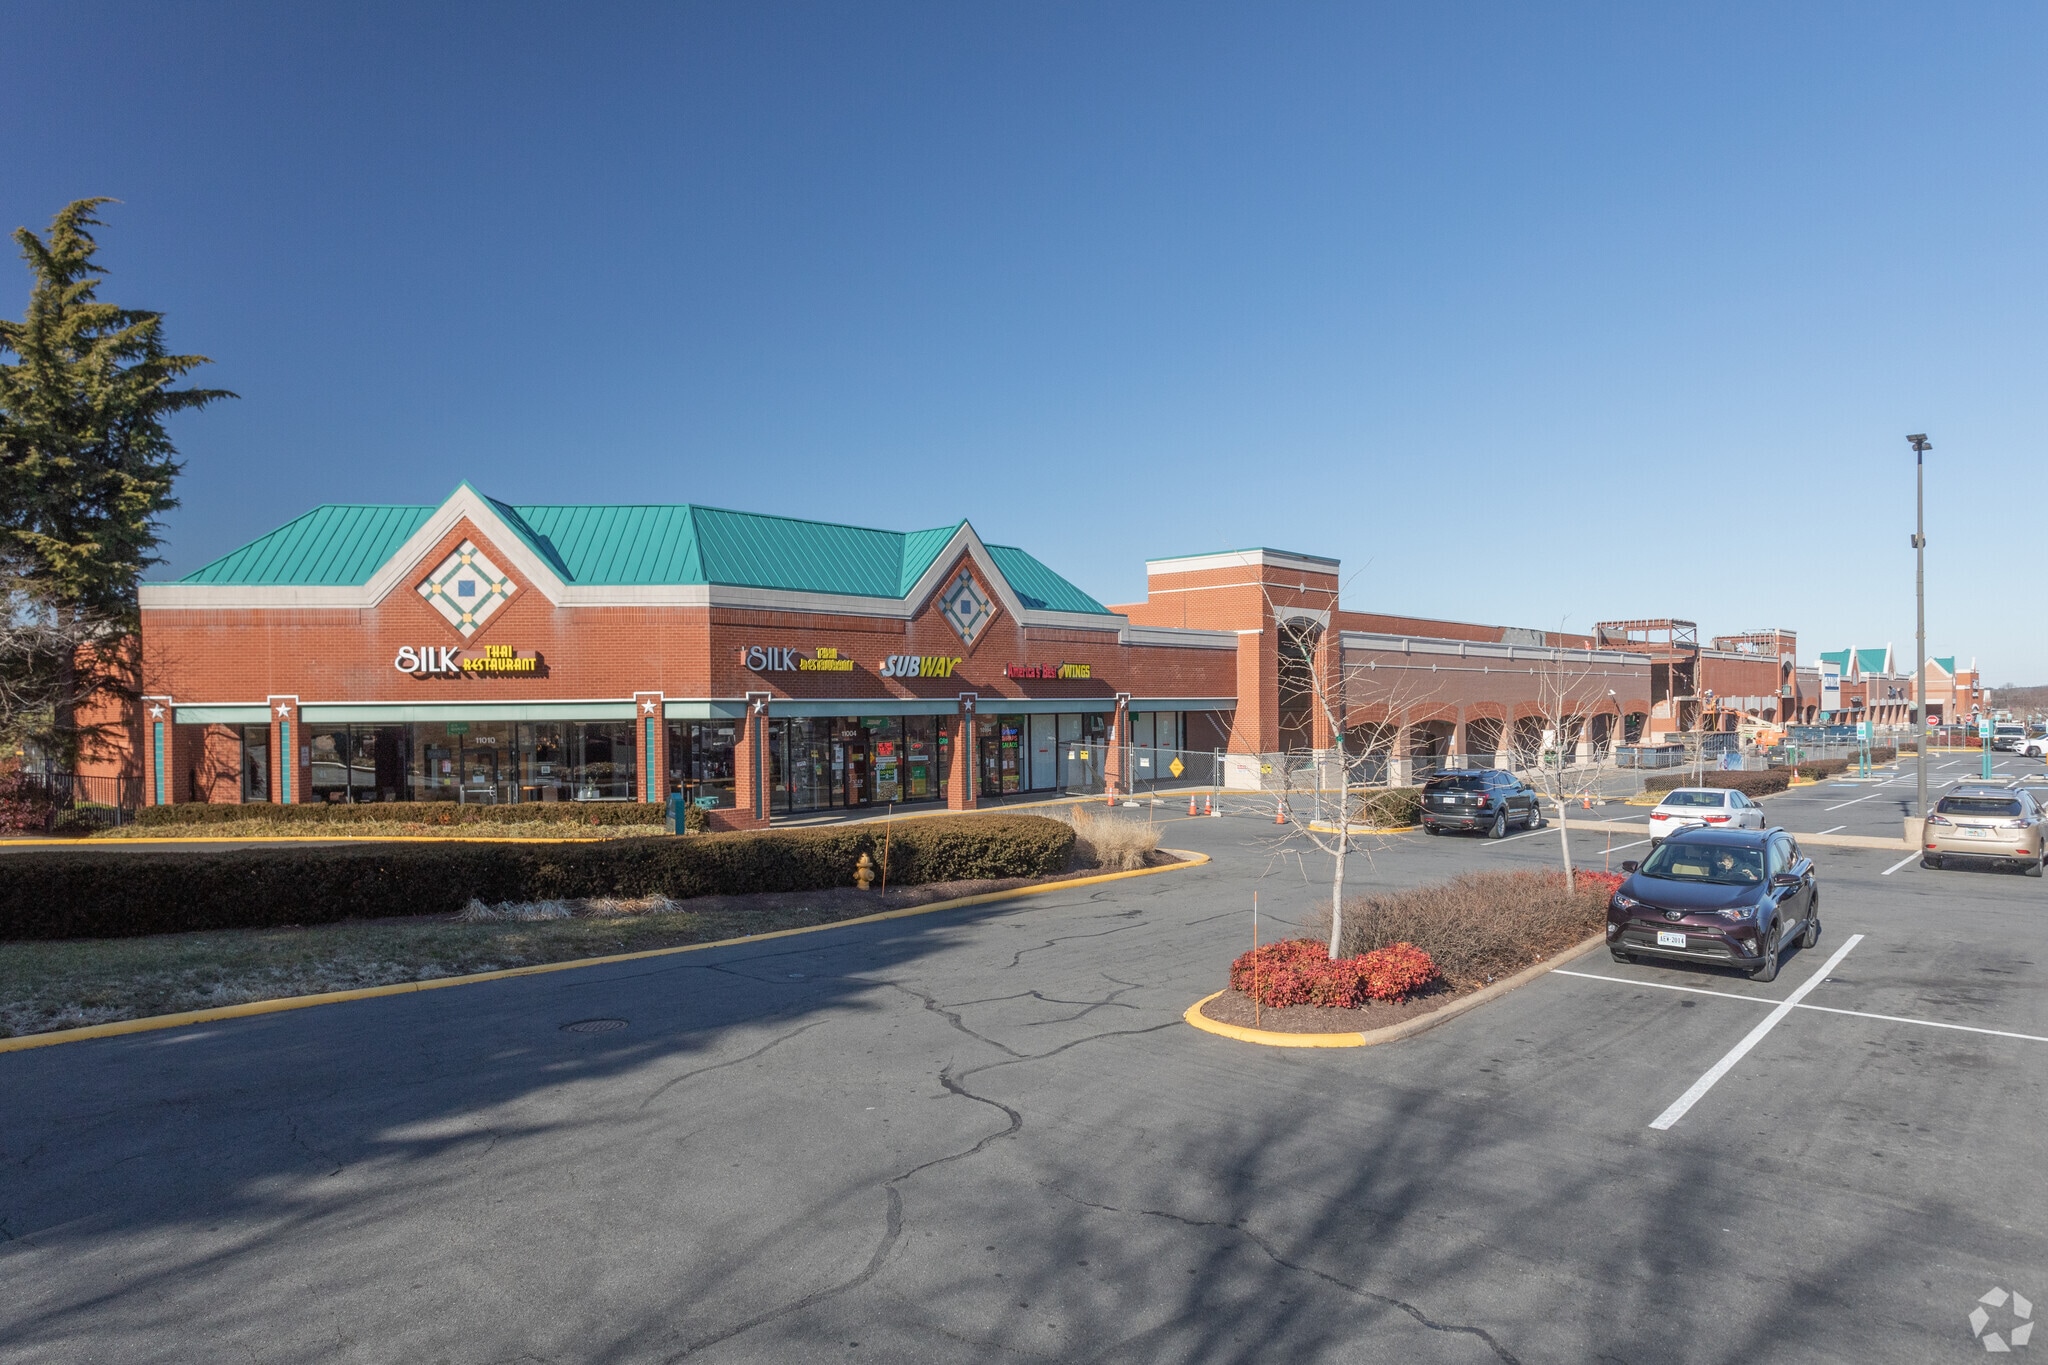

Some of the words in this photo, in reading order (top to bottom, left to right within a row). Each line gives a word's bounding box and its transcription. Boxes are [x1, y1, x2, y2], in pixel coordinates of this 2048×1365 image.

[484, 645, 513, 658] THAI
[746, 646, 797, 671] SILK
[395, 646, 460, 673] SILK
[463, 658, 537, 671] RESTAURANT
[881, 656, 962, 678] SUBWAY
[1063, 664, 1091, 678] WINGS
[475, 736, 496, 744] 11010
